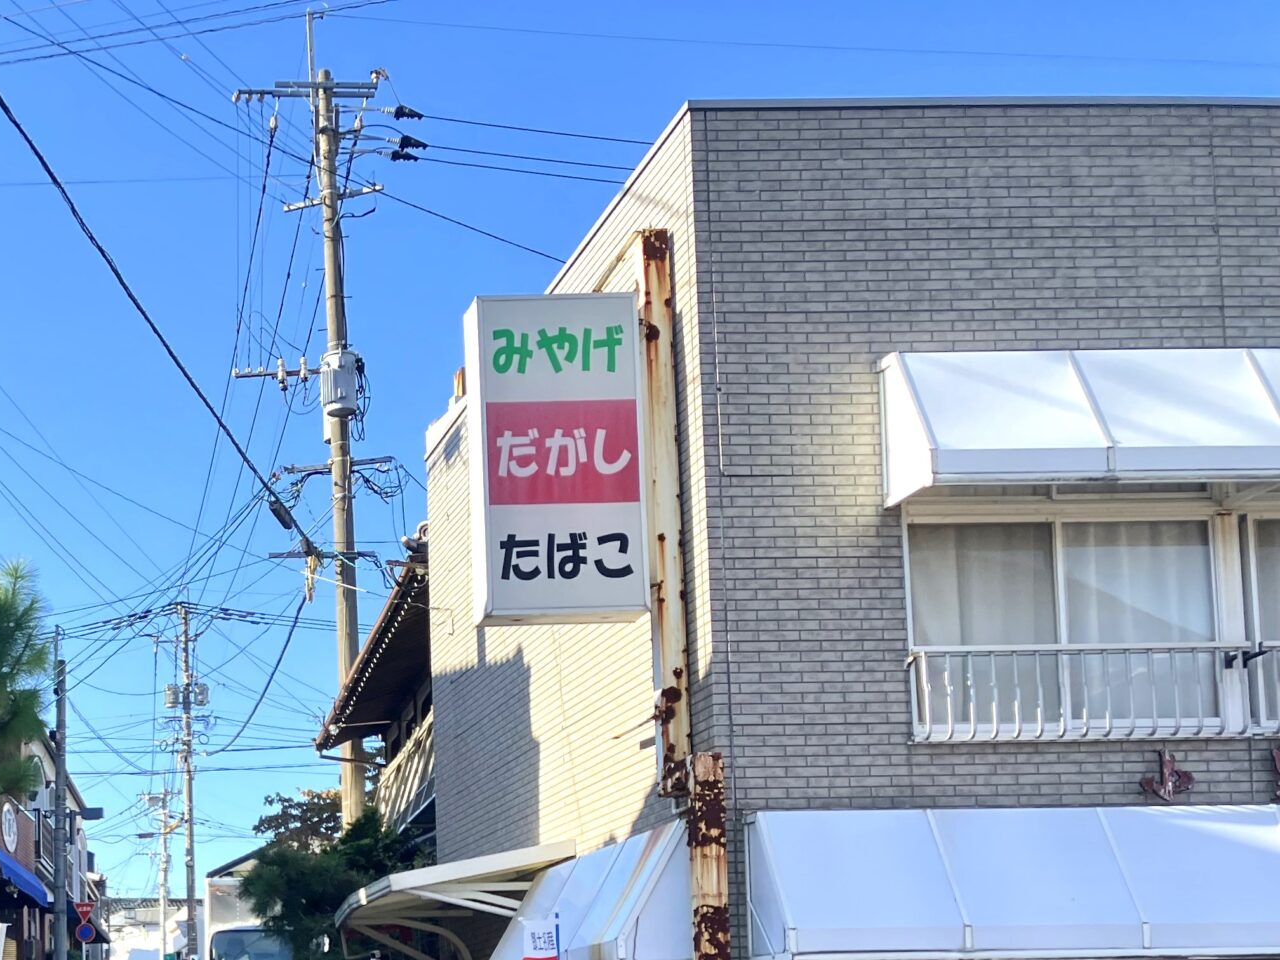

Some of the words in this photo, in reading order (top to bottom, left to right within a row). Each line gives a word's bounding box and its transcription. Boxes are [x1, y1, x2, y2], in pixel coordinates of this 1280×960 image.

[492, 325, 624, 374] みやげ
[496, 428, 632, 477] だがし
[499, 531, 634, 580] たばこ
